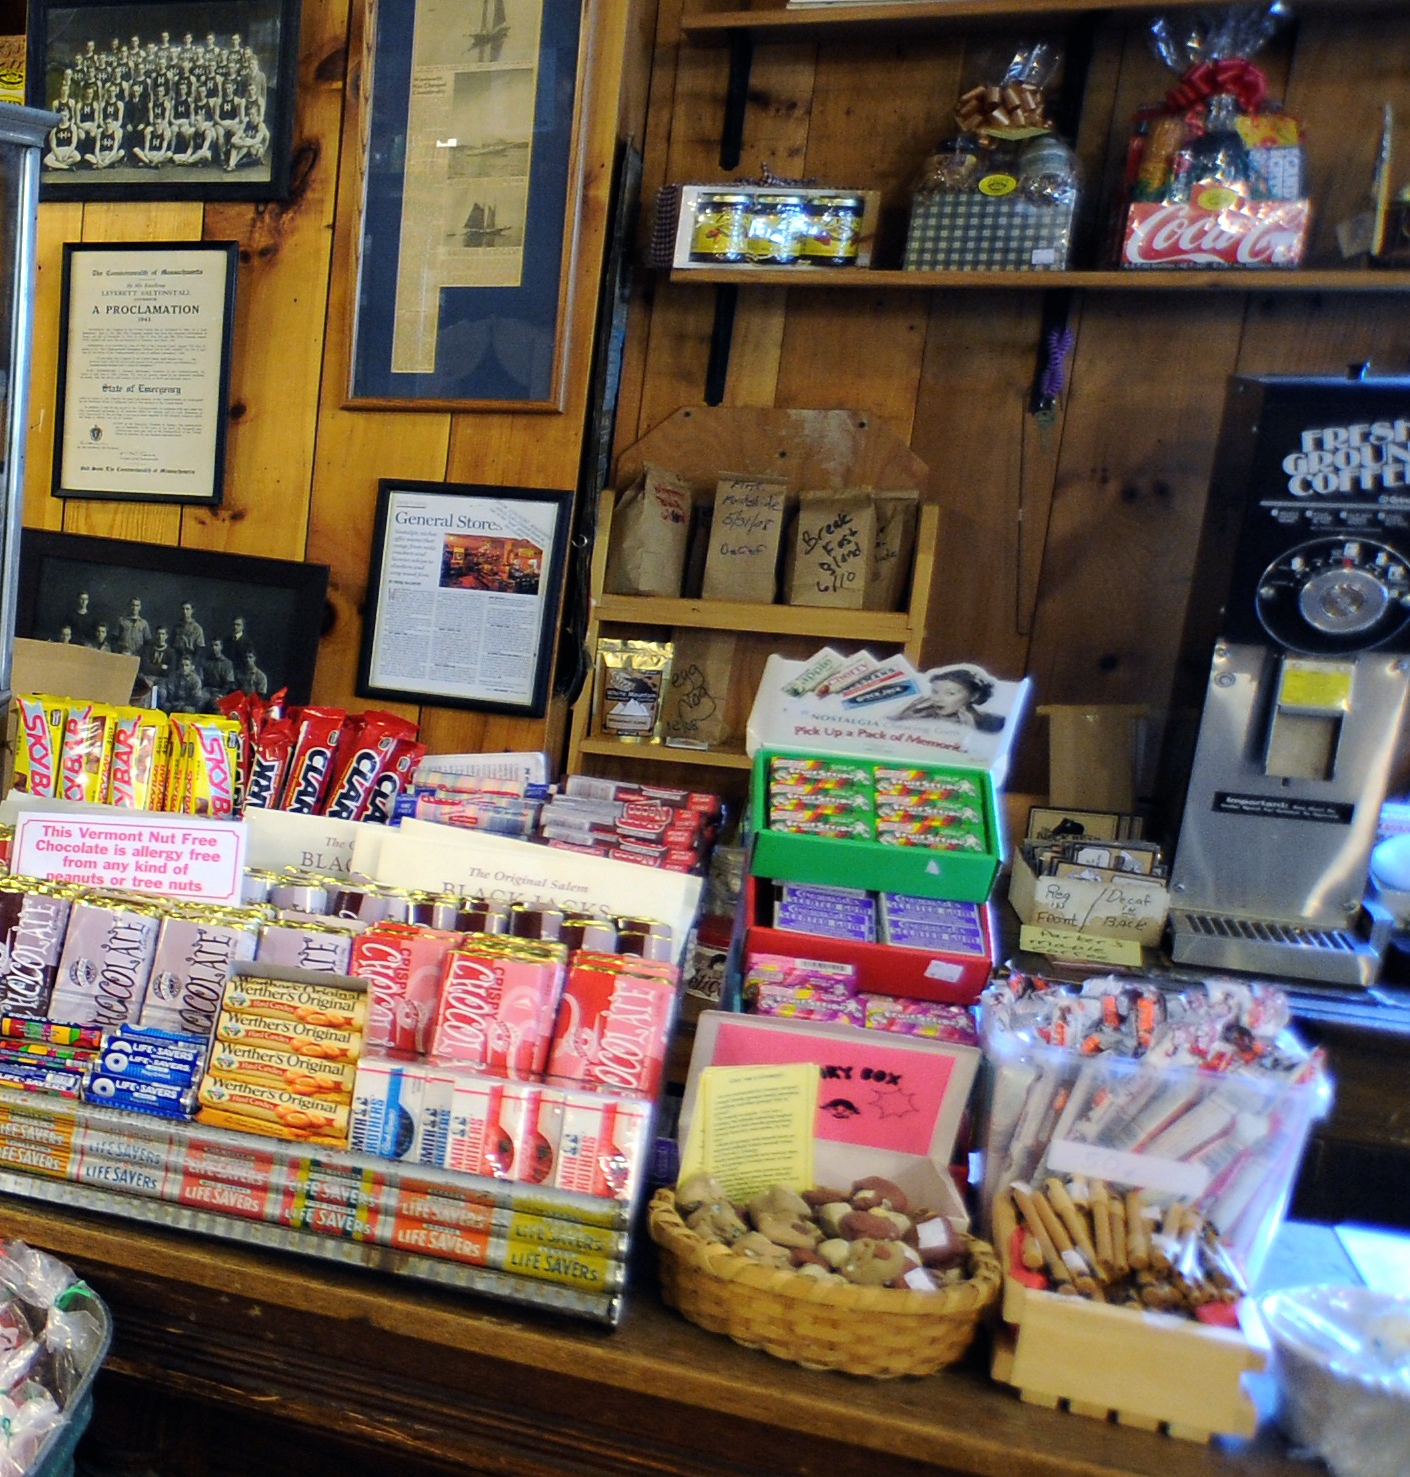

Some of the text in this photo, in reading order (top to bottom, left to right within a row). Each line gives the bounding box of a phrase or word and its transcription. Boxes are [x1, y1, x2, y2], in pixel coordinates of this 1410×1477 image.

[92, 304, 201, 316] A PROCLAMATION
[395, 511, 454, 529] General
[811, 712, 879, 728] NOSTALGIA
[794, 725, 821, 737] Pick
[824, 727, 843, 739] Up
[858, 728, 886, 740] Pack
[890, 732, 905, 742] of
[42, 825, 217, 847] This Vermont Nut Free
[324, 836, 346, 850] The
[36, 839, 221, 862] Chocolate is allergy free
[63, 856, 189, 875] from any kind of
[46, 871, 202, 892] peanuts or tree nuts
[468, 866, 589, 894] The Original Salem
[1046, 884, 1152, 906] Reg Decaf
[233, 981, 355, 1011] Werther's Original
[229, 1012, 351, 1043] Werther's Original
[221, 1042, 345, 1076] Werther's Original
[860, 1067, 902, 1085] BOX
[115, 1080, 179, 1100] LIFE SAVERS
[213, 1077, 337, 1113] Werther's Original
[18, 1151, 61, 1171] SAVERS
[86, 1165, 158, 1190] LIFE SAVERS
[185, 1185, 261, 1213] LIFE SAVERS
[285, 1206, 371, 1235] LIFE SAVERS
[398, 1228, 481, 1258] LIFE SAVERS
[511, 1252, 598, 1282] LIFE SAVERS
